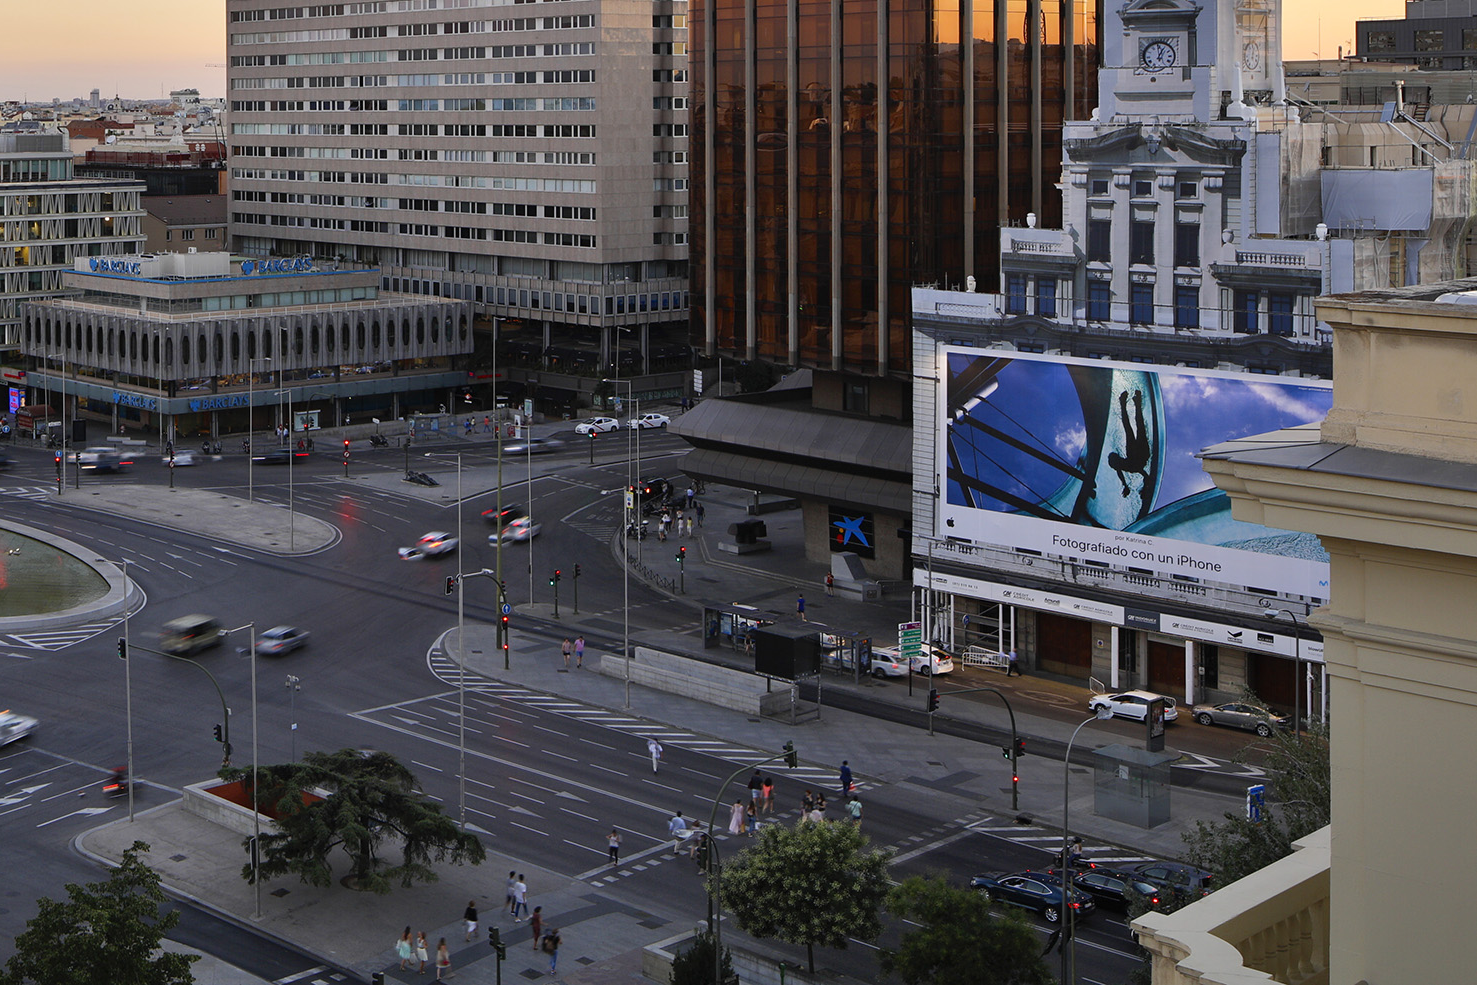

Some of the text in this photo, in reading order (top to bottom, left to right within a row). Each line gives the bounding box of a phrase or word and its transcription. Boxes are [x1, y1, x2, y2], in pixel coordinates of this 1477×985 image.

[100, 259, 141, 275] BARCLAYS
[258, 257, 313, 273] BARCLAYS
[121, 395, 156, 410] BARCLAYS
[202, 395, 250, 410] BARCLAYS
[1126, 536, 1146, 545] Katrina
[1052, 534, 1222, 572] Fotografiado con un iPhone
